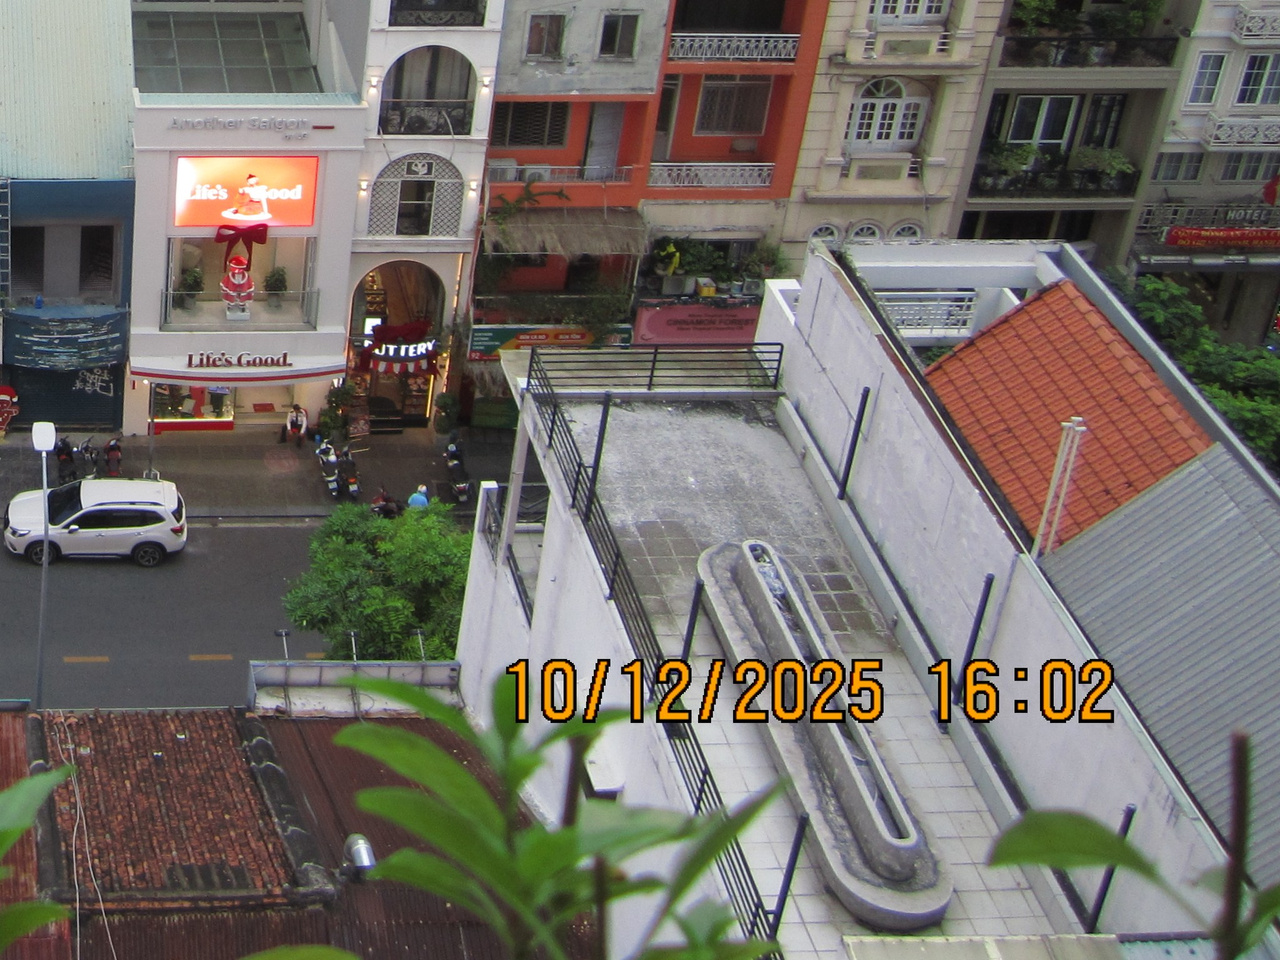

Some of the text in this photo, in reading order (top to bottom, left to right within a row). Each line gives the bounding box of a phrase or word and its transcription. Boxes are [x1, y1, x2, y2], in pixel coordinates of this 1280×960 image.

[247, 116, 309, 132] Saigon
[1226, 210, 1268, 220] HOTEL
[364, 339, 436, 357] UTTERY
[187, 351, 293, 368] Life's Good.
